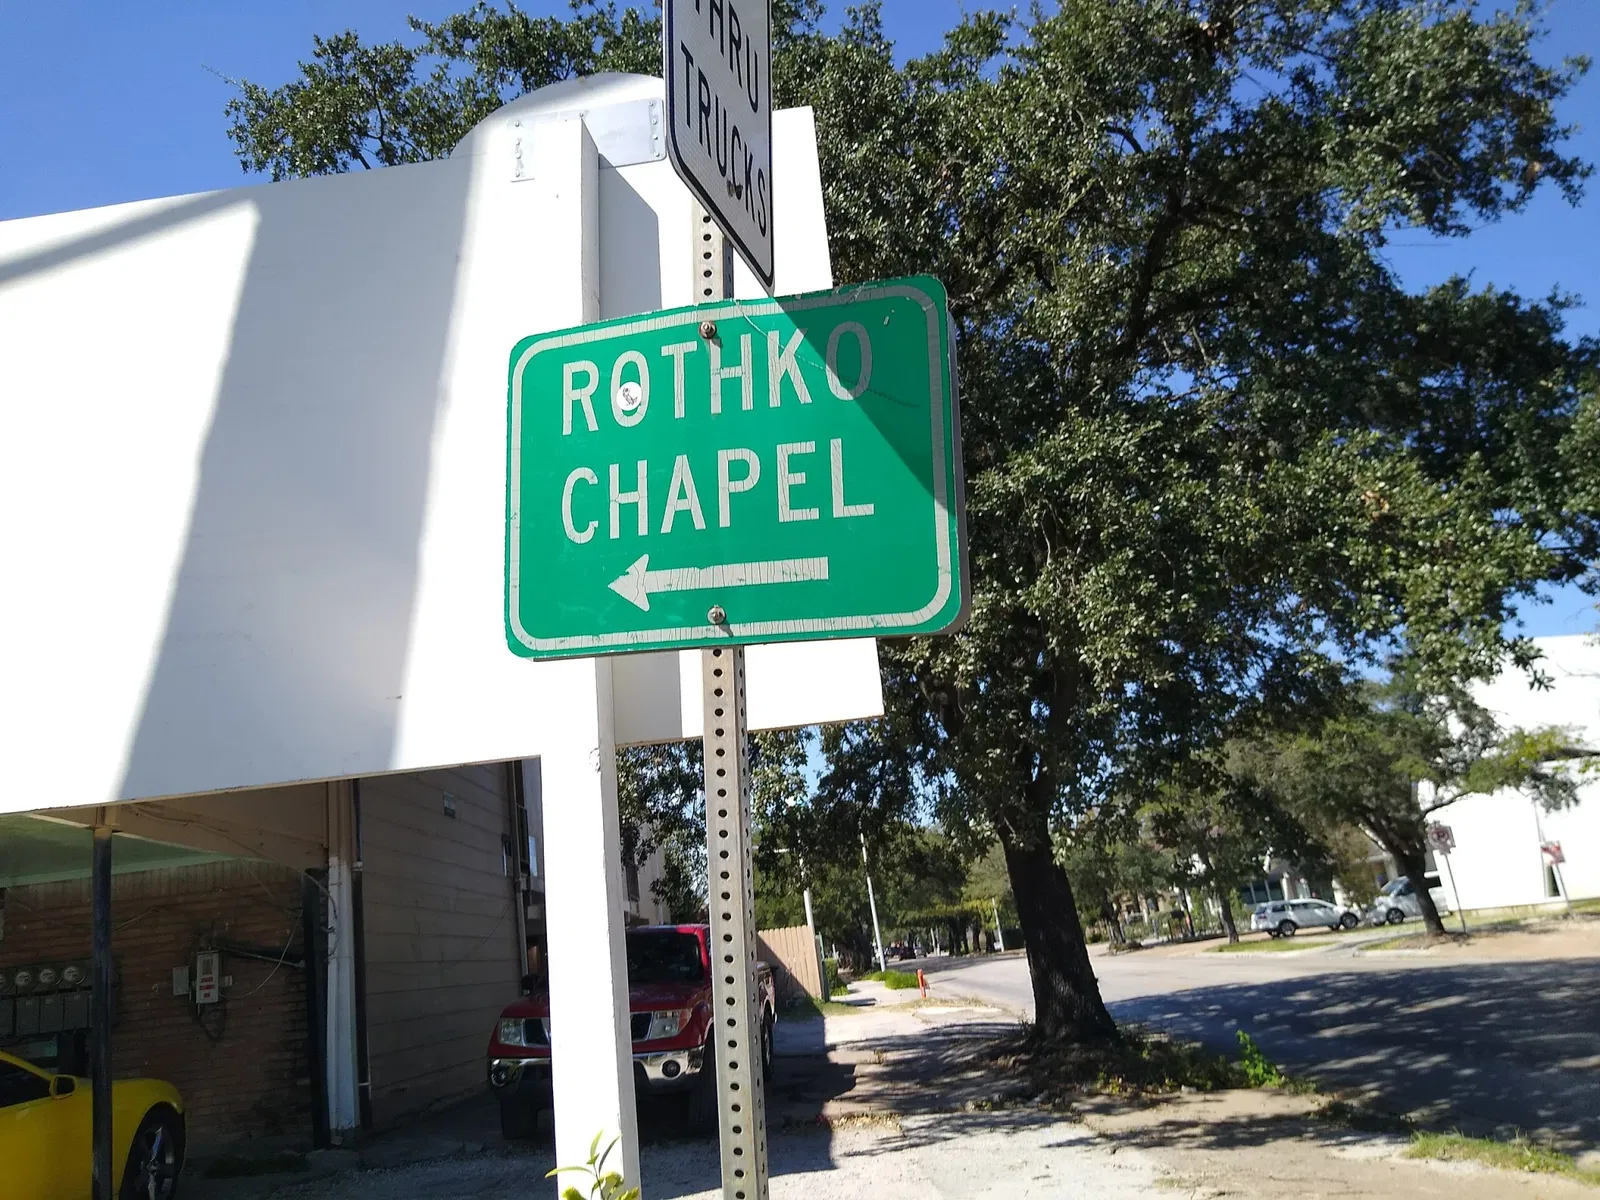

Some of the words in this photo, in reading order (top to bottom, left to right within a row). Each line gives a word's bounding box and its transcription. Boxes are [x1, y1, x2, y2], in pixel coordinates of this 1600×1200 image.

[695, 0, 759, 113] HRU
[680, 40, 767, 237] TRUCKS
[562, 320, 873, 435] ROTHKO
[561, 438, 876, 544] CHAPEL
